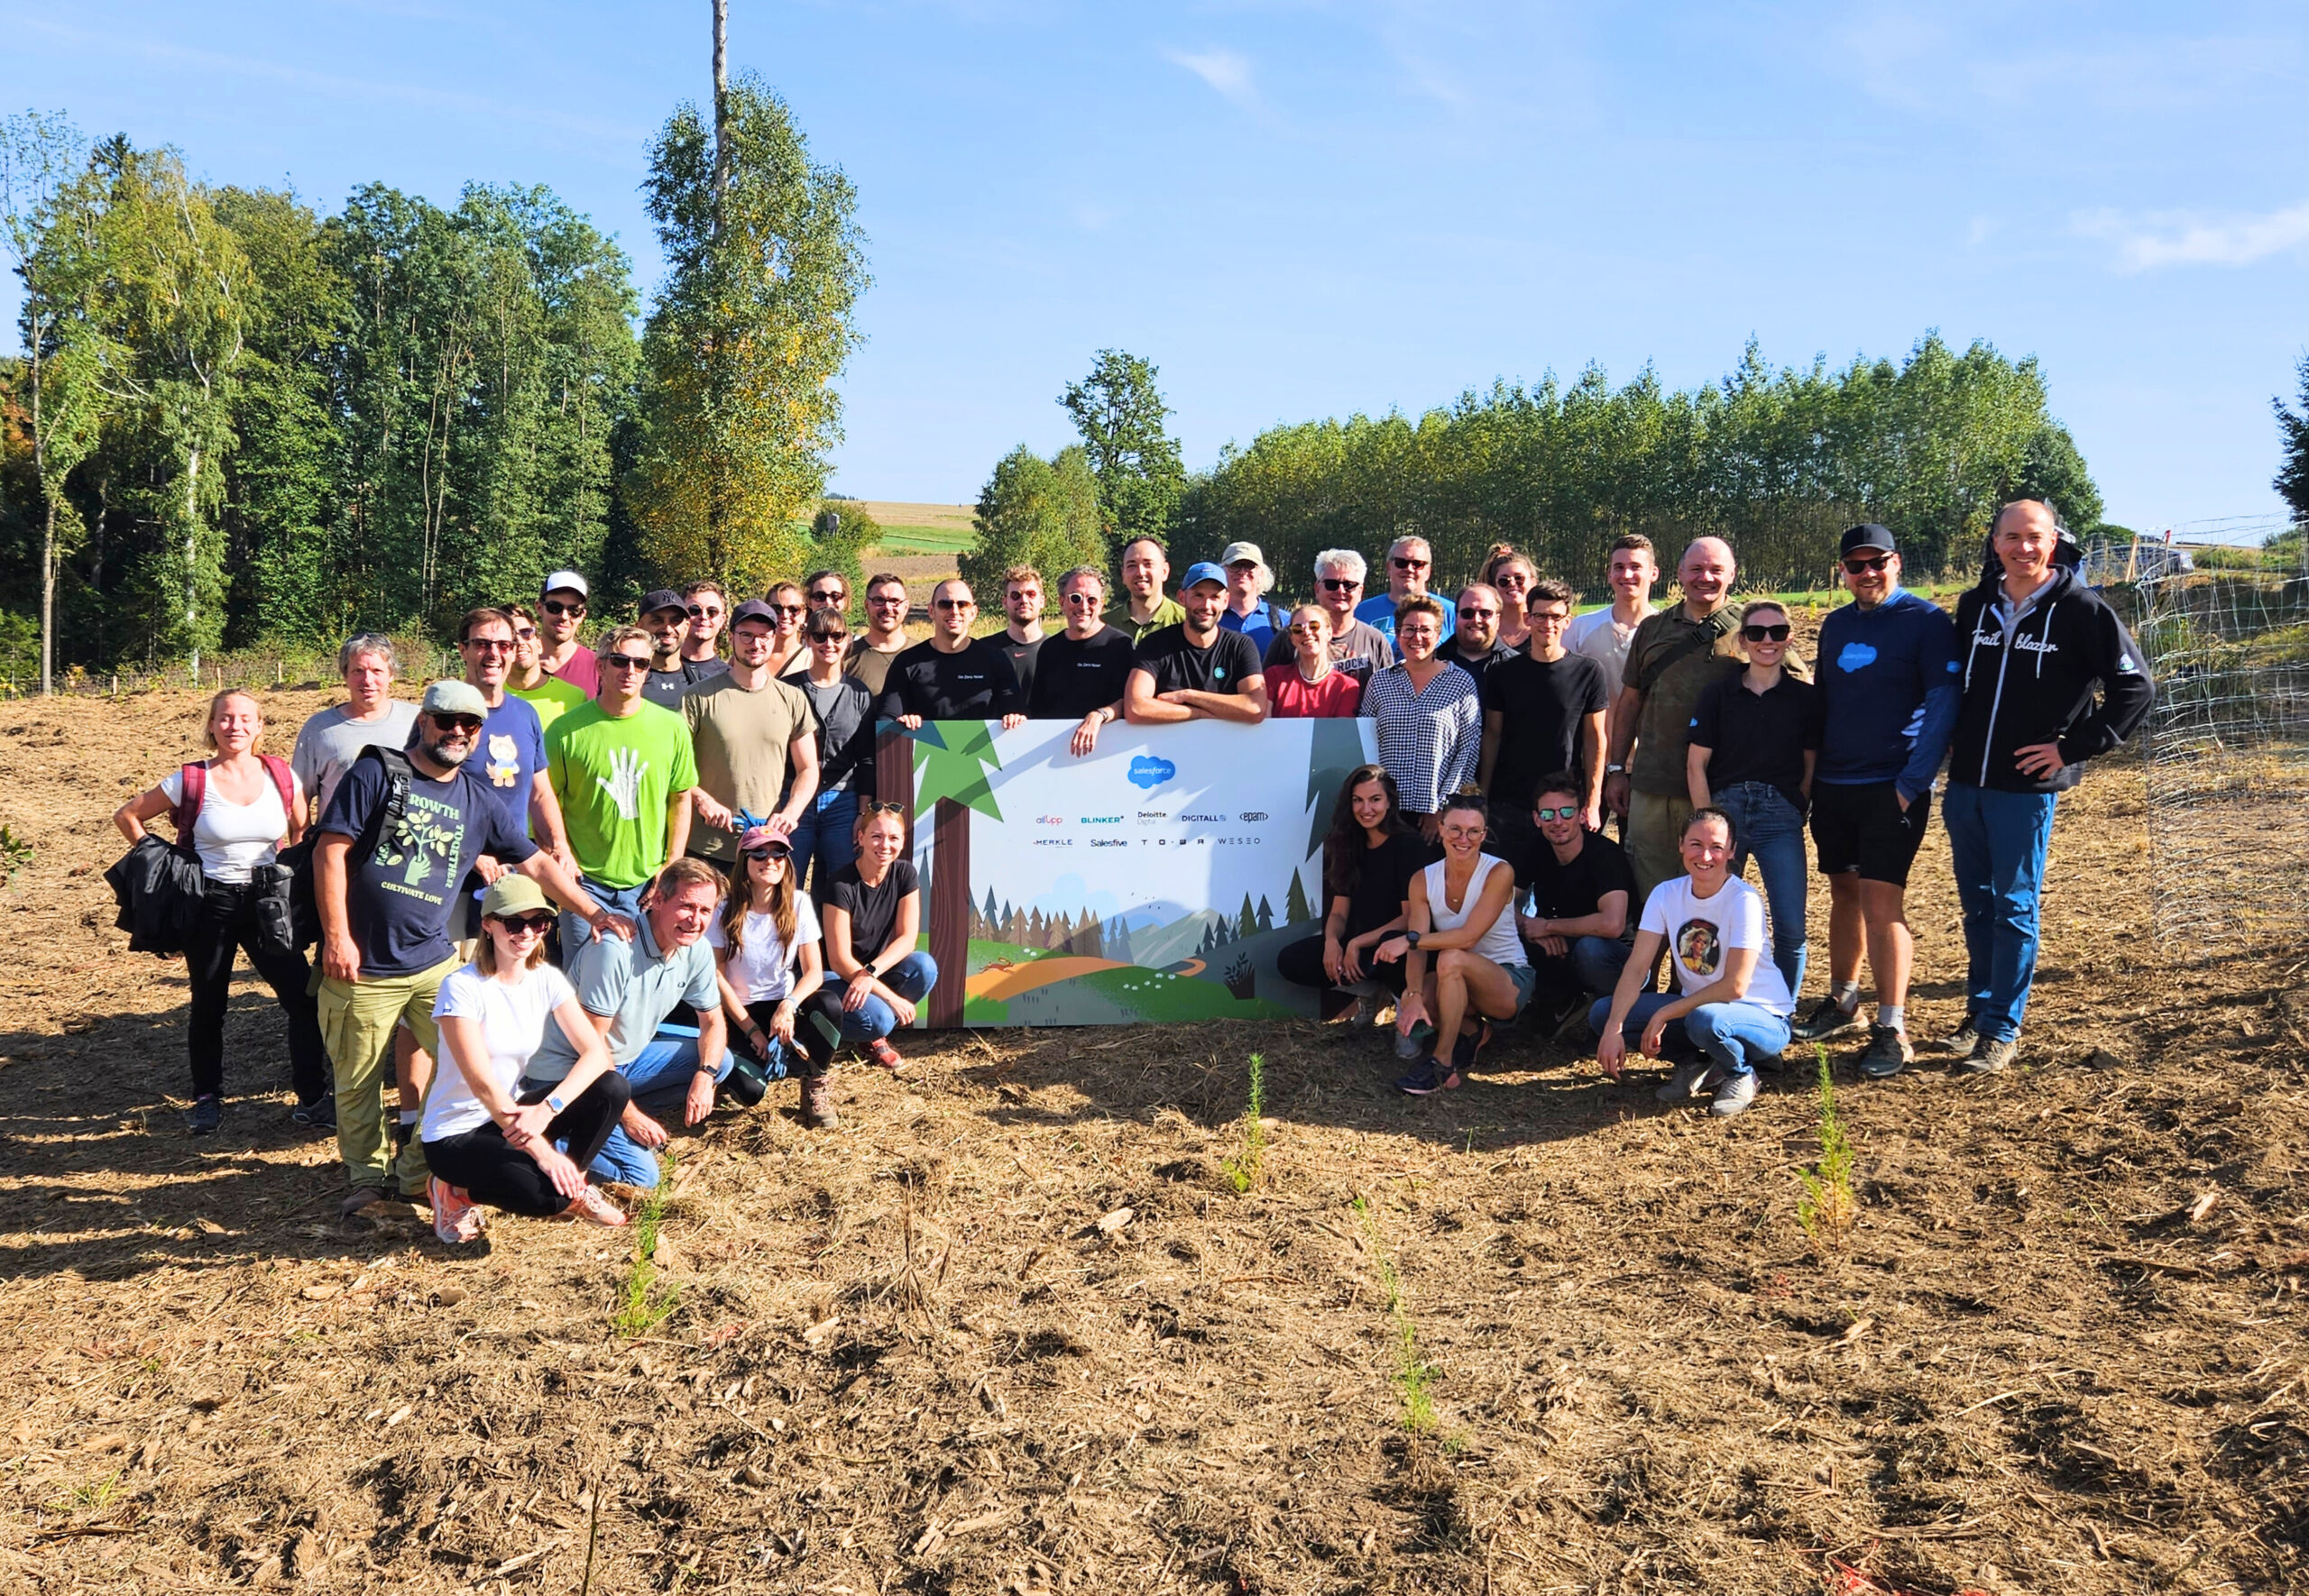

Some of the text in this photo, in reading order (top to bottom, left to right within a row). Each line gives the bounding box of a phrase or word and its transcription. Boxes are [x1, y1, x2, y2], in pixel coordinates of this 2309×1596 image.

[1972, 629, 2003, 647] Trail
[1337, 657, 1365, 672] ROCK
[1134, 766, 1172, 776] salesforce
[409, 793, 460, 821] ROWTH
[1081, 816, 1120, 824] BLINKER
[1090, 839, 1127, 848] Salesfive
[445, 824, 465, 888] TOGETHER
[381, 881, 424, 900] CULTIVATE
